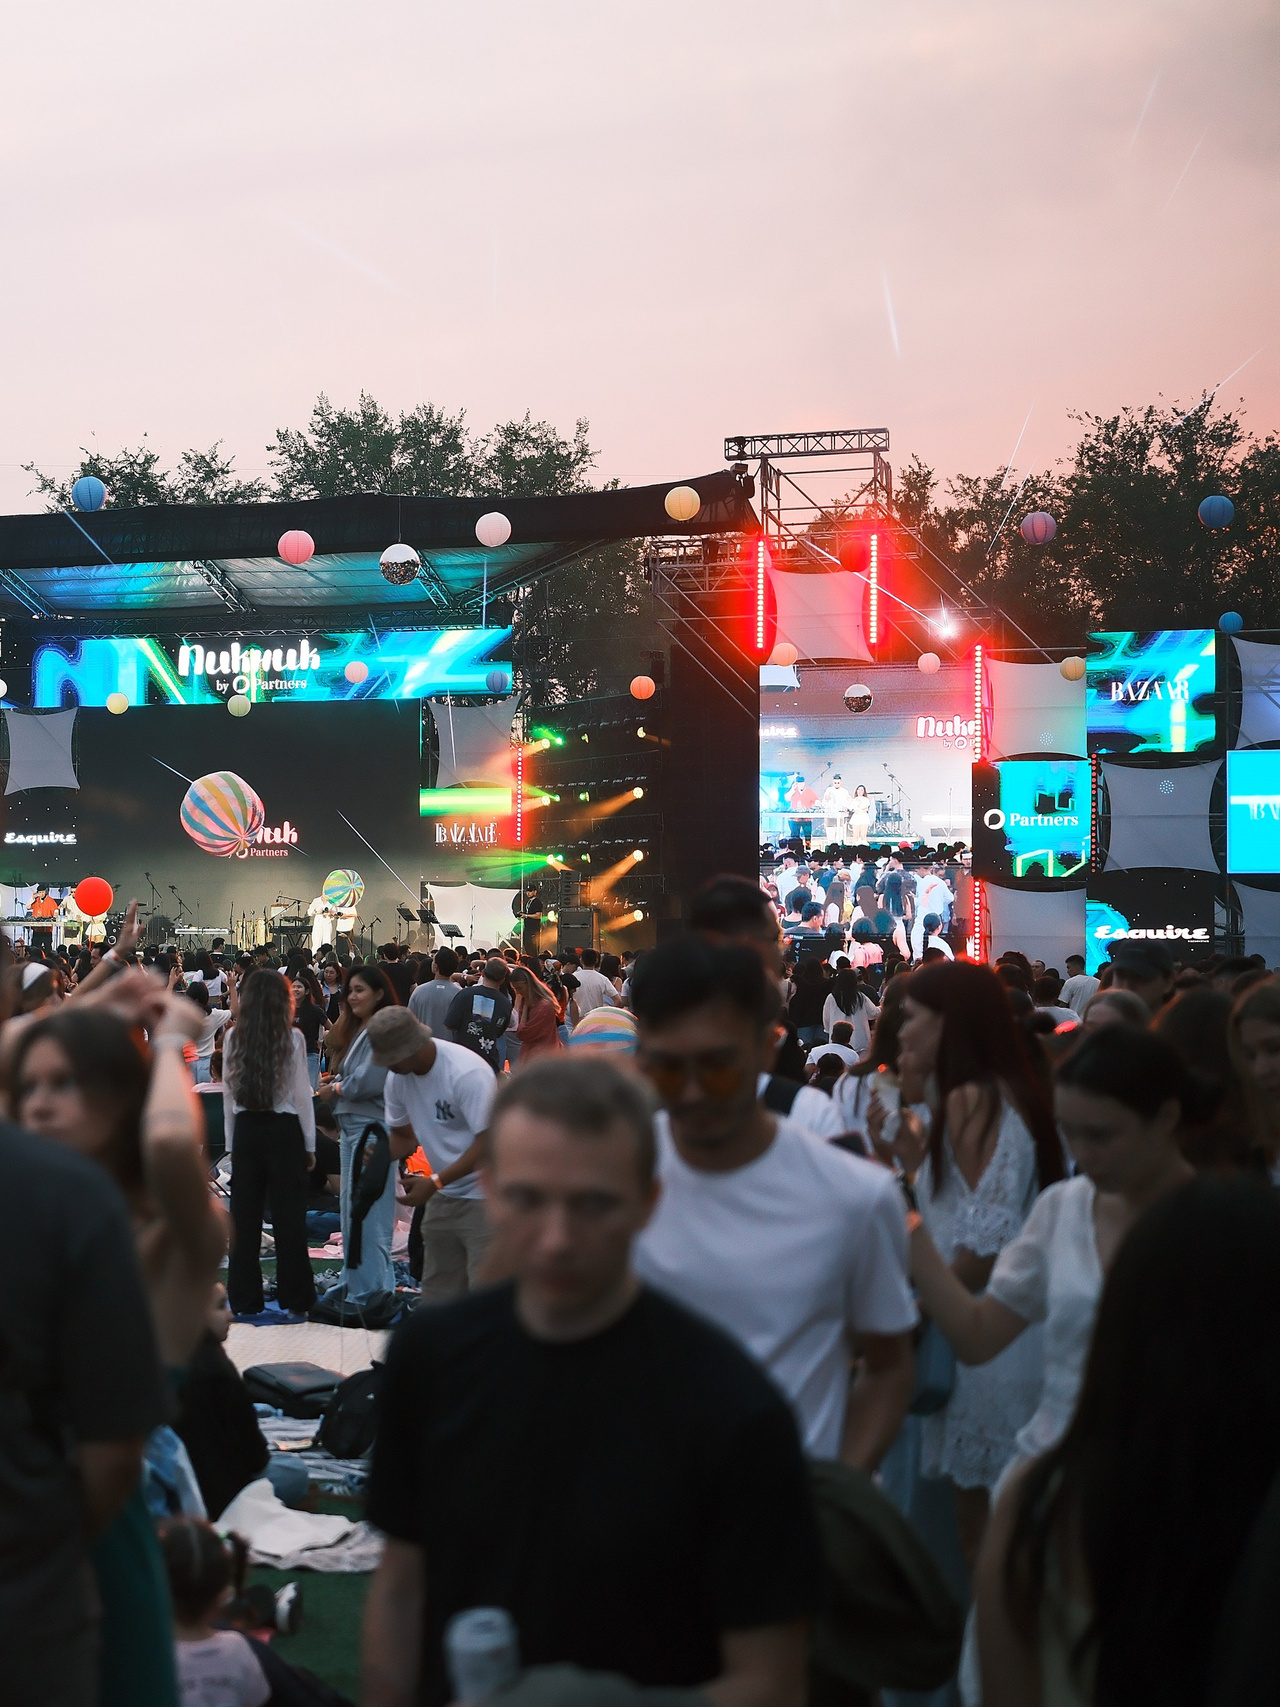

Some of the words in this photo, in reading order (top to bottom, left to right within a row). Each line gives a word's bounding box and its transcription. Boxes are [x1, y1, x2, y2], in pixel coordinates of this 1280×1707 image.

[216, 680, 229, 694] by
[255, 679, 307, 690] Partners
[1111, 681, 1190, 701] BAZAAR
[1010, 813, 1079, 826] Partners
[4, 832, 77, 846] Esquire
[250, 848, 289, 857] Partners
